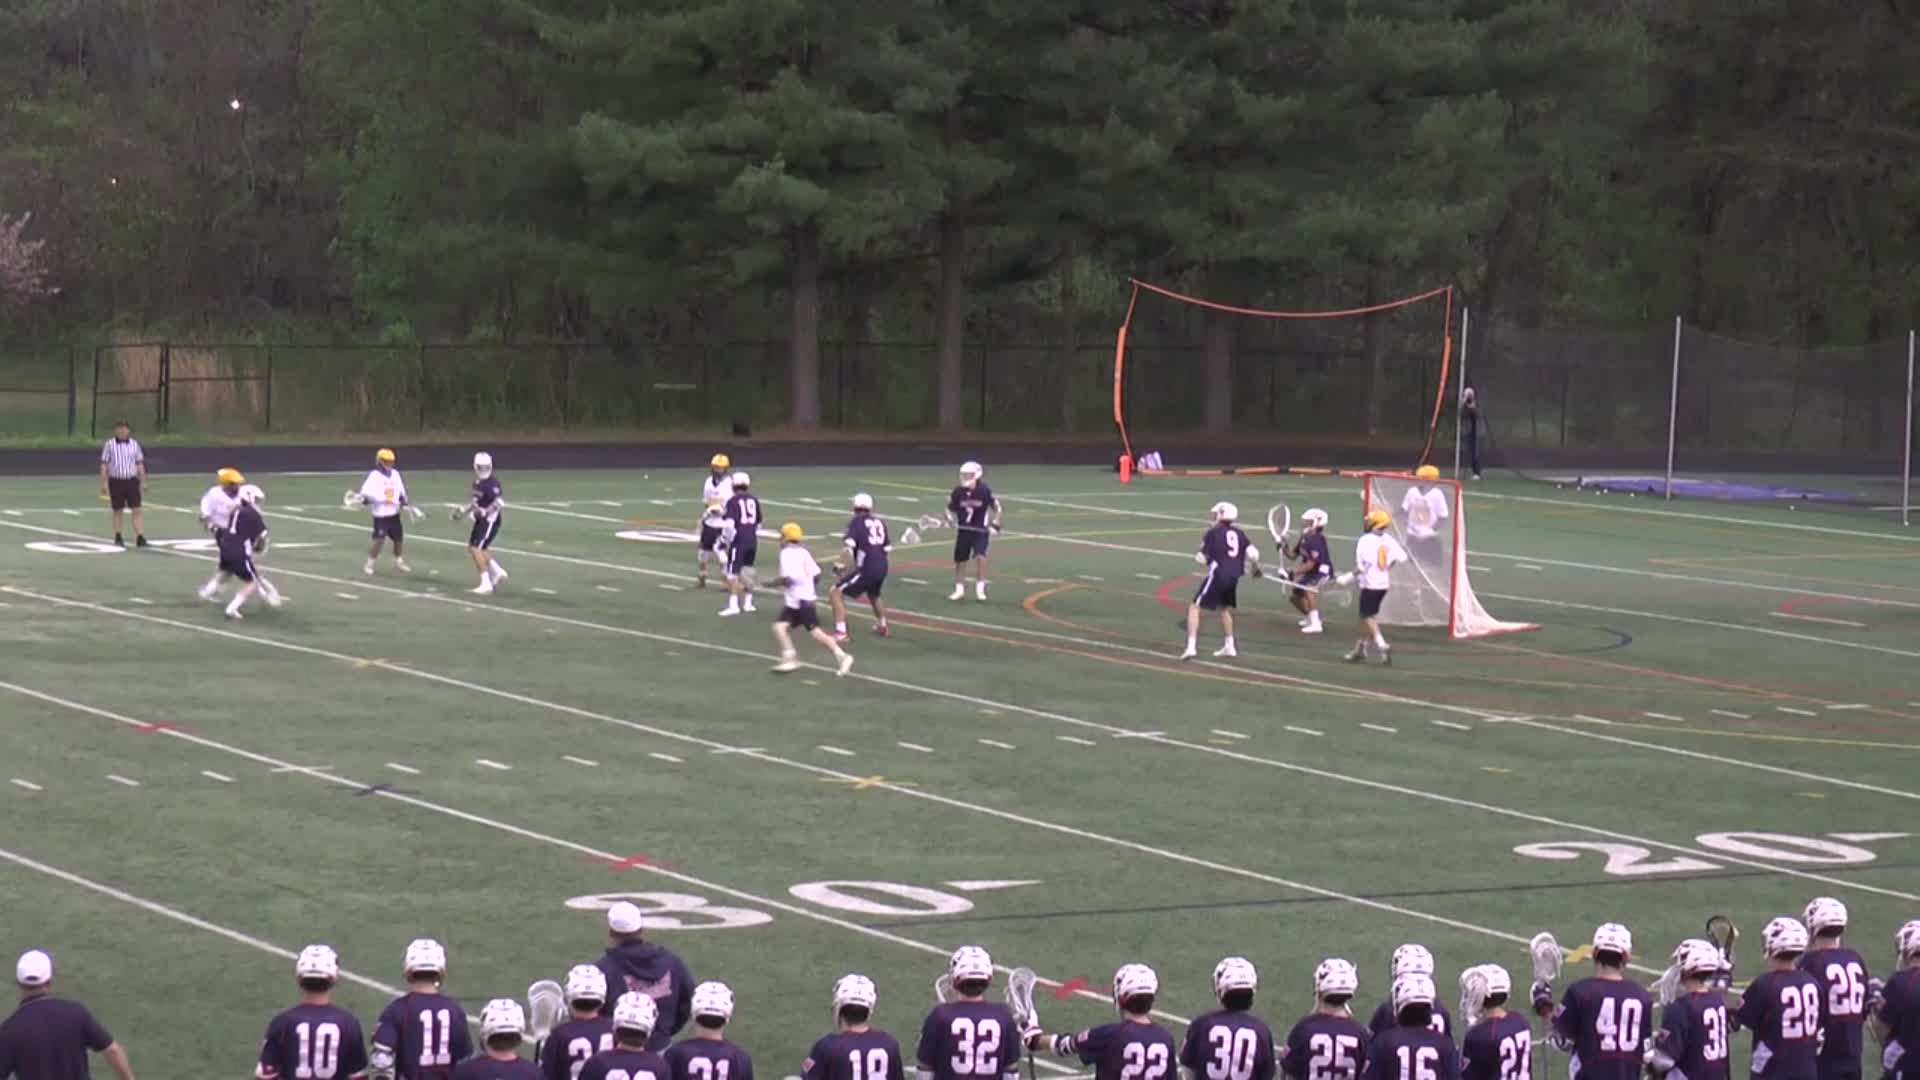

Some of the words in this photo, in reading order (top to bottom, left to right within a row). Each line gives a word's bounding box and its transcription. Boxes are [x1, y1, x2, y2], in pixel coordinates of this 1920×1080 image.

[738, 498, 757, 524] 19
[865, 518, 885, 545] 33
[1226, 530, 1239, 558] 9
[1513, 832, 1878, 875] 20
[1781, 983, 1819, 1038] 28
[1826, 962, 1865, 1015] 26
[295, 1022, 340, 1079] 10
[419, 1009, 451, 1066] 11
[951, 1017, 1000, 1075] 32
[1596, 997, 1642, 1051] 40
[1703, 1006, 1727, 1060] 31
[1121, 1042, 1168, 1080] 22
[1206, 1025, 1257, 1080] 30
[1309, 1034, 1359, 1080] 25
[1397, 1046, 1439, 1080] 16
